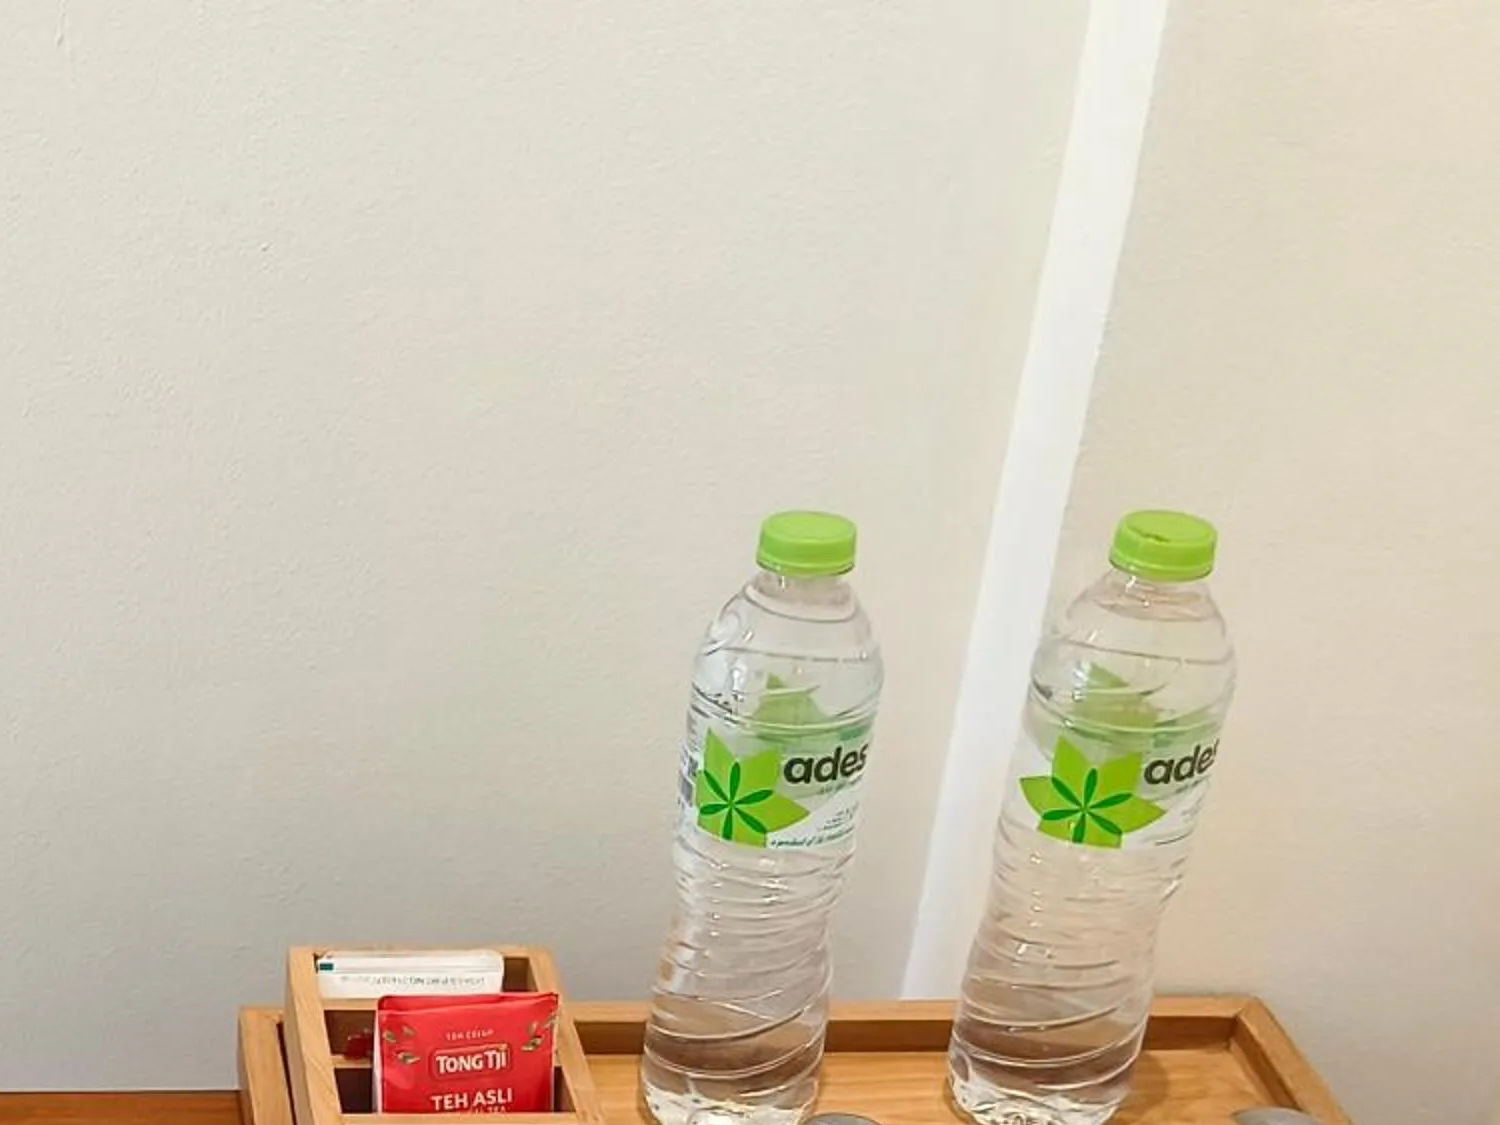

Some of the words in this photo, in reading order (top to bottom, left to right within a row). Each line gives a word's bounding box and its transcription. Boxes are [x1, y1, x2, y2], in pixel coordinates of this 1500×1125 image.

[436, 1054, 484, 1074] TONG
[431, 1092, 469, 1111] TEH
[472, 1088, 513, 1107] ASLI
